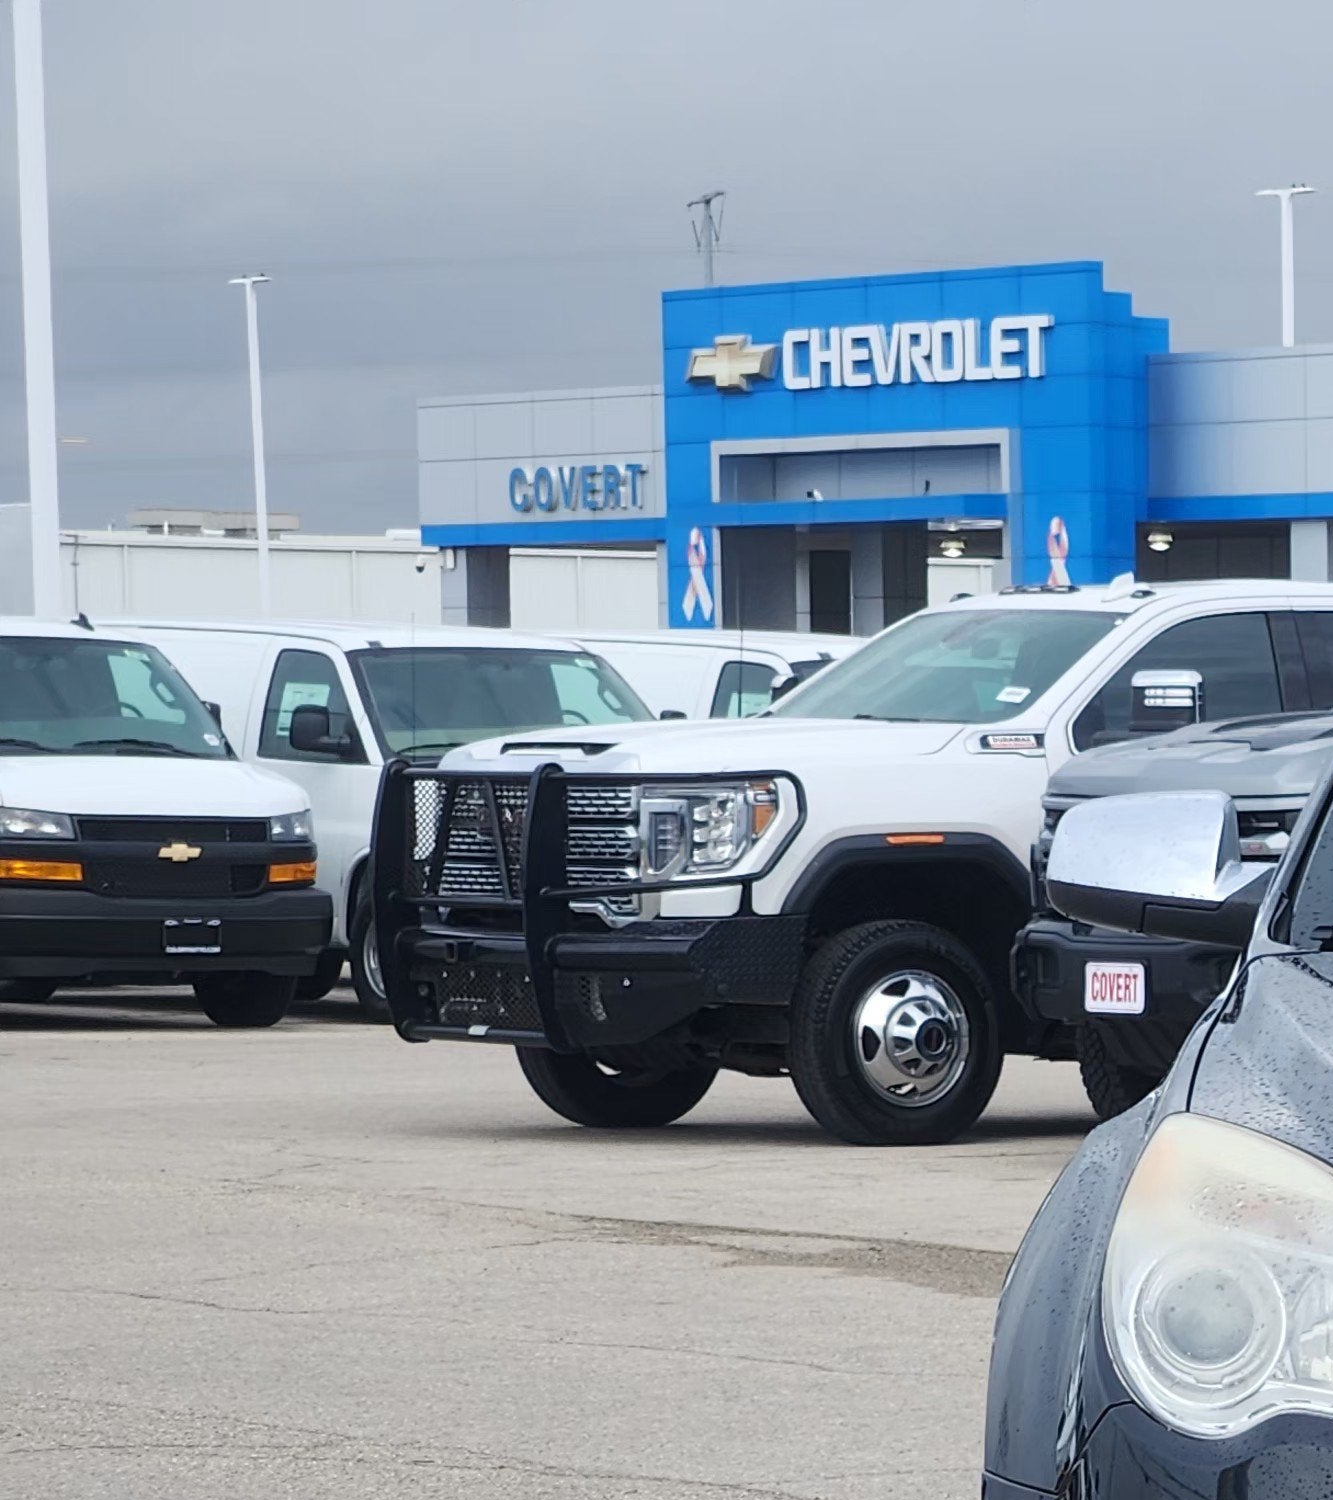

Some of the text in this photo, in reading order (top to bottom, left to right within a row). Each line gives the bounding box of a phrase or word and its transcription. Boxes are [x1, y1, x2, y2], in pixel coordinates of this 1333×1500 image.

[783, 314, 1054, 389] CHEVROLET
[509, 463, 647, 513] COVERT
[1091, 972, 1139, 1003] COVERT
